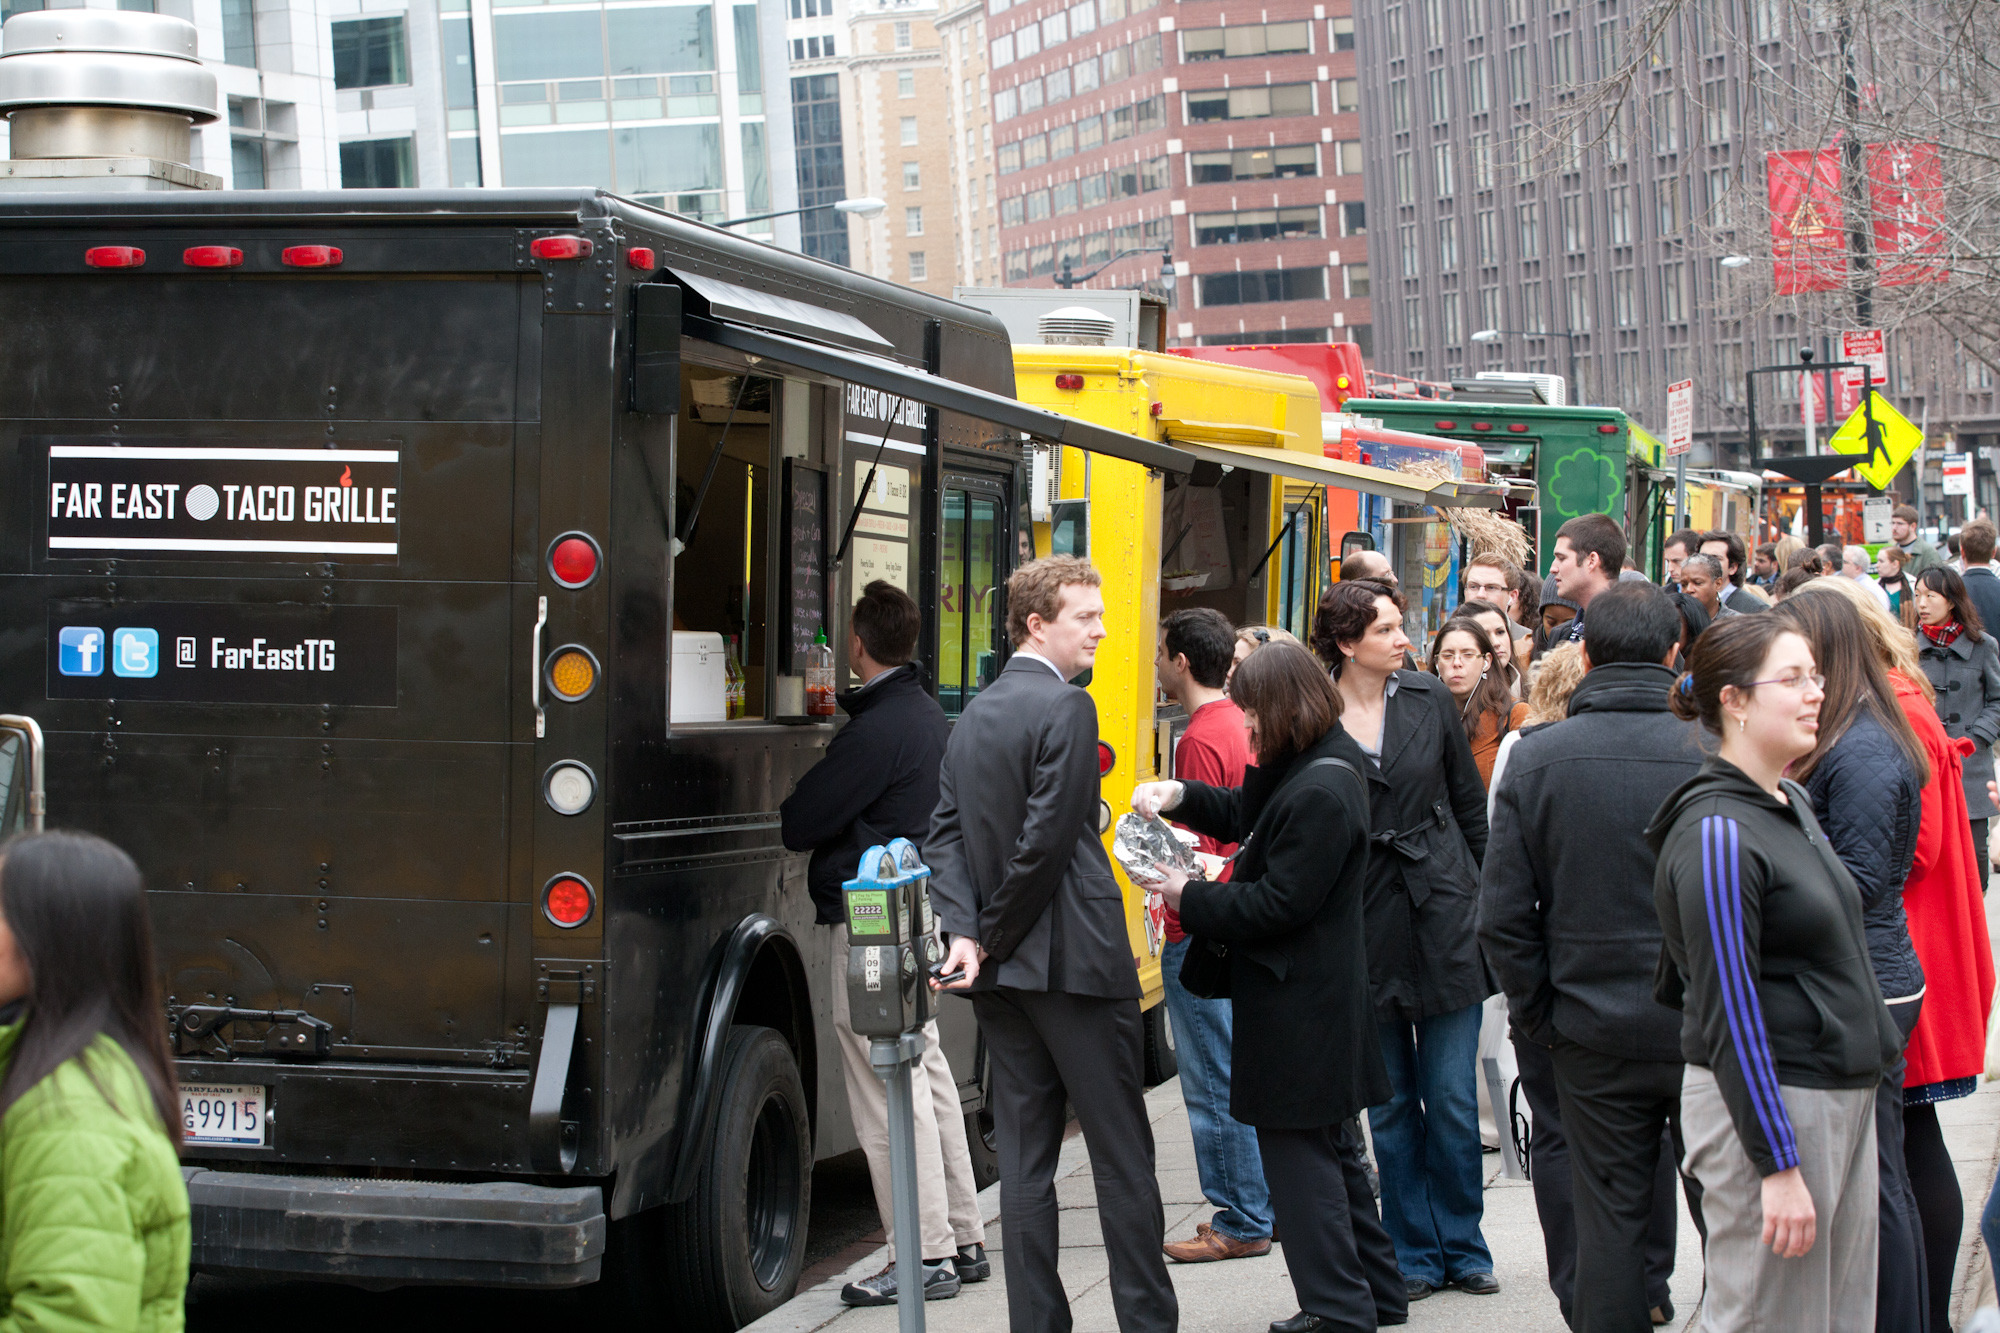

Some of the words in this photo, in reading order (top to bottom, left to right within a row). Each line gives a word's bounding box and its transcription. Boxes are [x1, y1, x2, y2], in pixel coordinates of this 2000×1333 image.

[847, 383, 860, 416] FAR
[861, 386, 879, 420] EAST
[51, 482, 102, 519] FAR
[111, 483, 180, 520] EAST
[223, 485, 295, 522] TACO
[304, 486, 397, 524] GRILLE
[176, 637, 196, 669] @
[211, 637, 336, 672] FarEastTG
[854, 906, 882, 914] 22222
[867, 959, 879, 967] 09
[178, 1086, 233, 1094] MARYLAND
[198, 1099, 257, 1131] 9915
